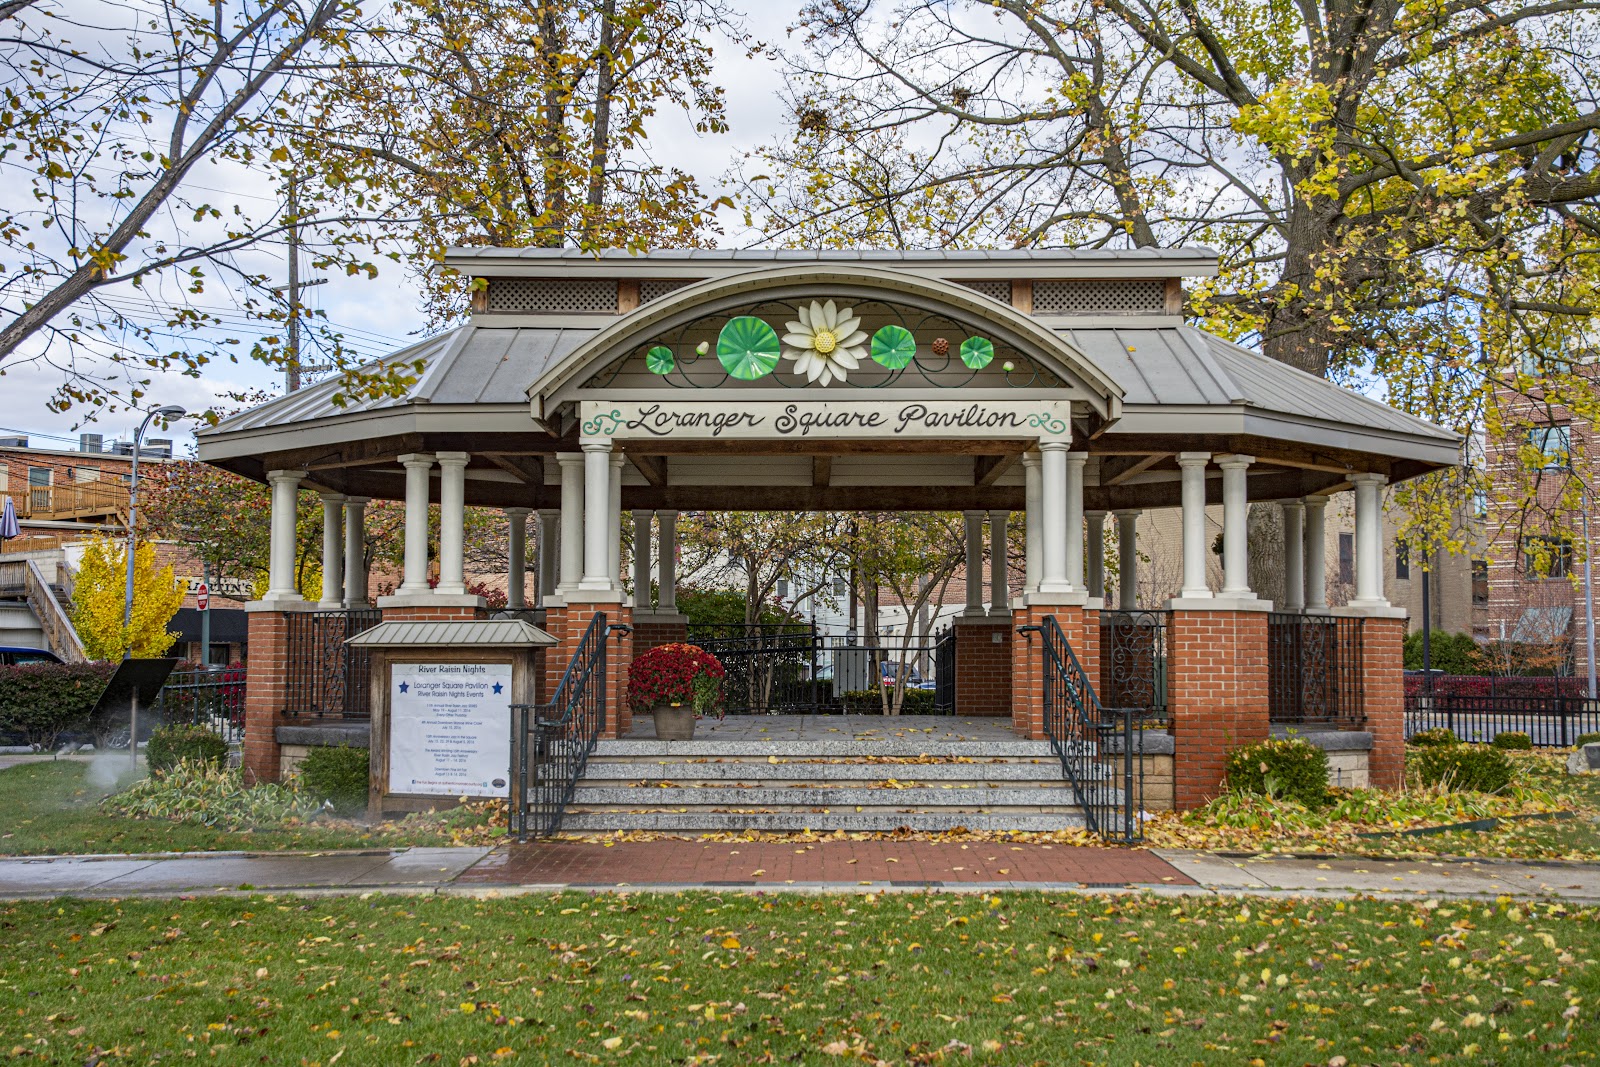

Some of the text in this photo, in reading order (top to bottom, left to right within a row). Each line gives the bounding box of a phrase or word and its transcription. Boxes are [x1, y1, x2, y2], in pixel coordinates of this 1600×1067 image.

[626, 404, 1028, 437] Loranger Square Pavilion
[418, 665, 486, 675] River Raisin Nights
[414, 682, 489, 690] Loranger Square Pavilion
